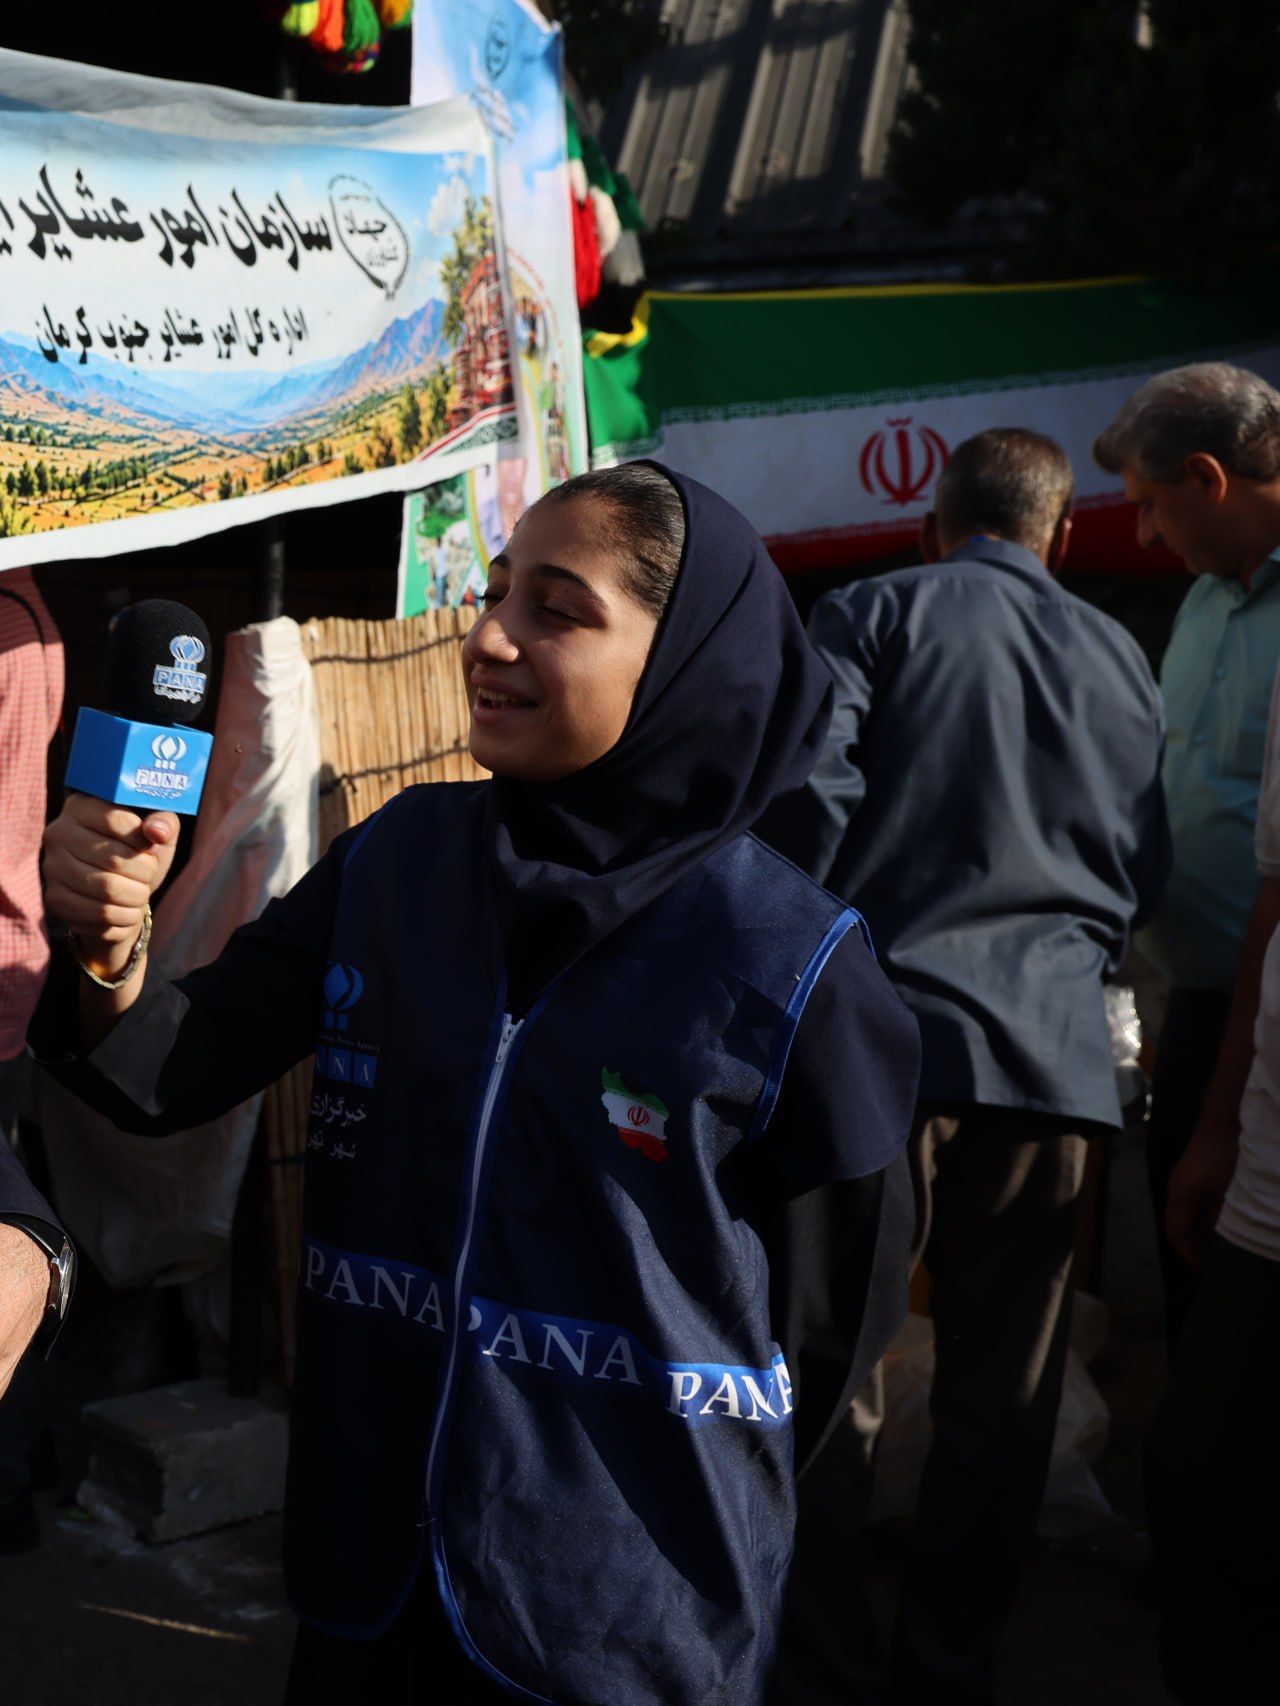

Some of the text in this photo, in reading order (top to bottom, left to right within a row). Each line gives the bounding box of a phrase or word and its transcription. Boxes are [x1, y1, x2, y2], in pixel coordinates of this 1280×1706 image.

[19, 163, 145, 261] عشایر
[150, 182, 219, 269] امور
[219, 187, 332, 272] سازمان
[35, 303, 309, 364] اداره کل امور عشایر جنوب کرمان
[156, 670, 206, 692] PANA
[137, 769, 187, 790] PANA
[303, 1244, 448, 1333] PANA
